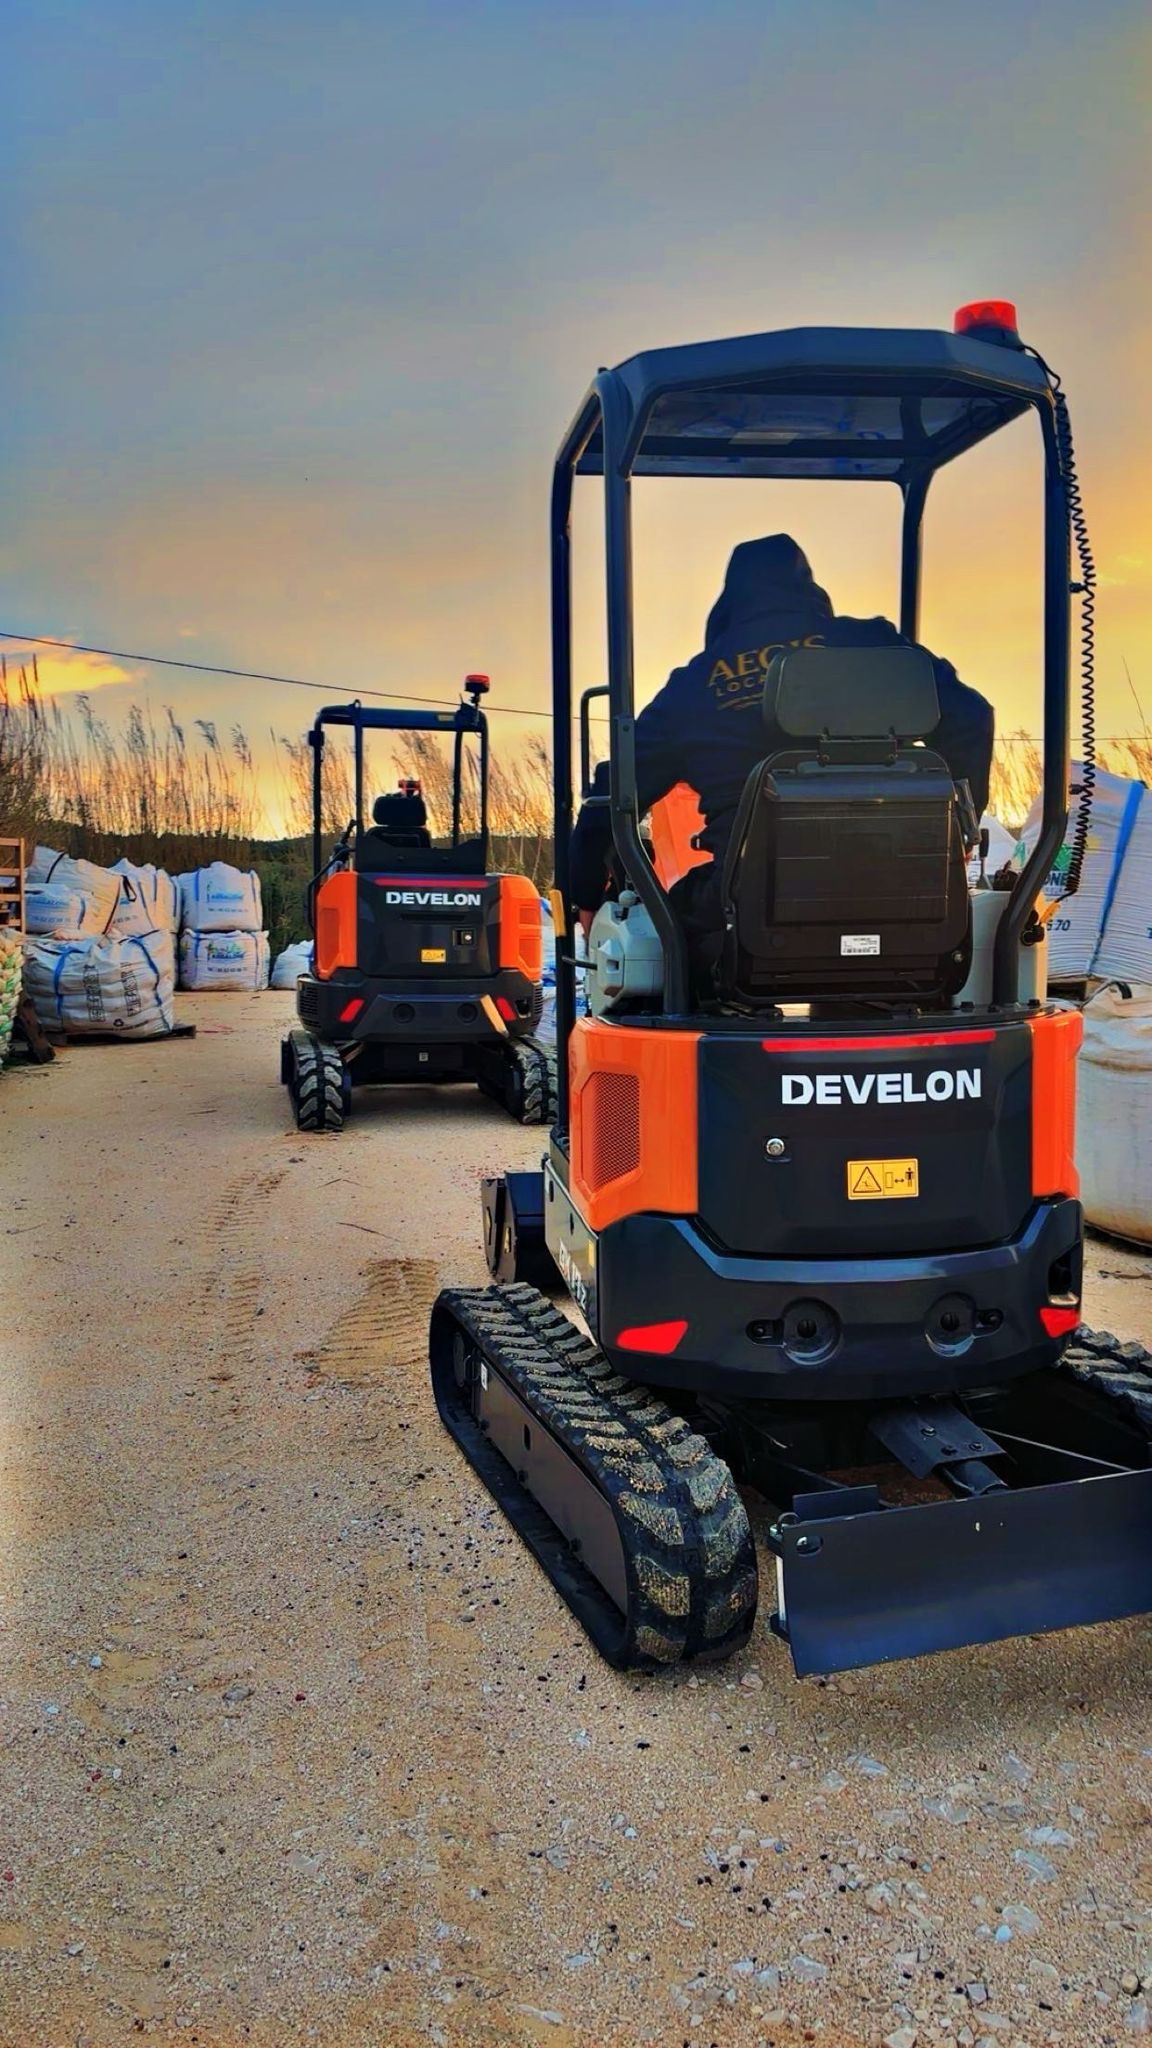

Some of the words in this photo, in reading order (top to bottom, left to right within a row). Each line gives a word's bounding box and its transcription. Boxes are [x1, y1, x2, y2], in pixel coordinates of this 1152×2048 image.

[385, 891, 481, 906] DEVELON
[1055, 919, 1071, 931] 70
[781, 1068, 982, 1105] DEVELON
